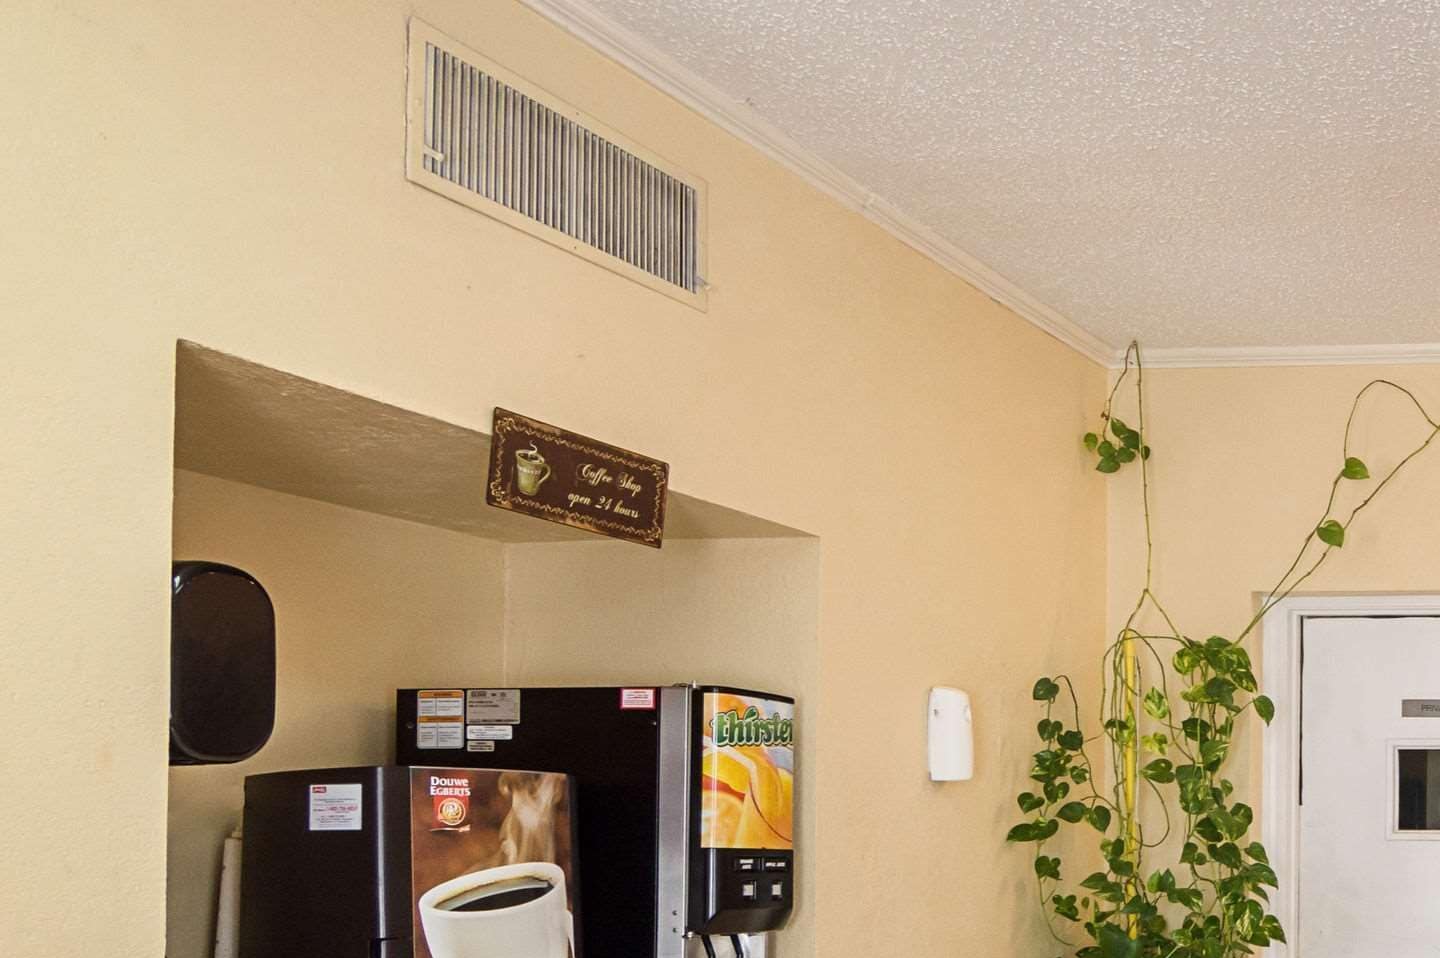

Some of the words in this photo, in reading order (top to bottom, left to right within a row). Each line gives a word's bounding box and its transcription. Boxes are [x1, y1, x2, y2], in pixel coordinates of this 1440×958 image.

[577, 463, 613, 486] Coffee
[617, 473, 641, 496] Shop
[568, 493, 591, 507] open
[595, 495, 613, 511] 24
[613, 500, 639, 518] hours
